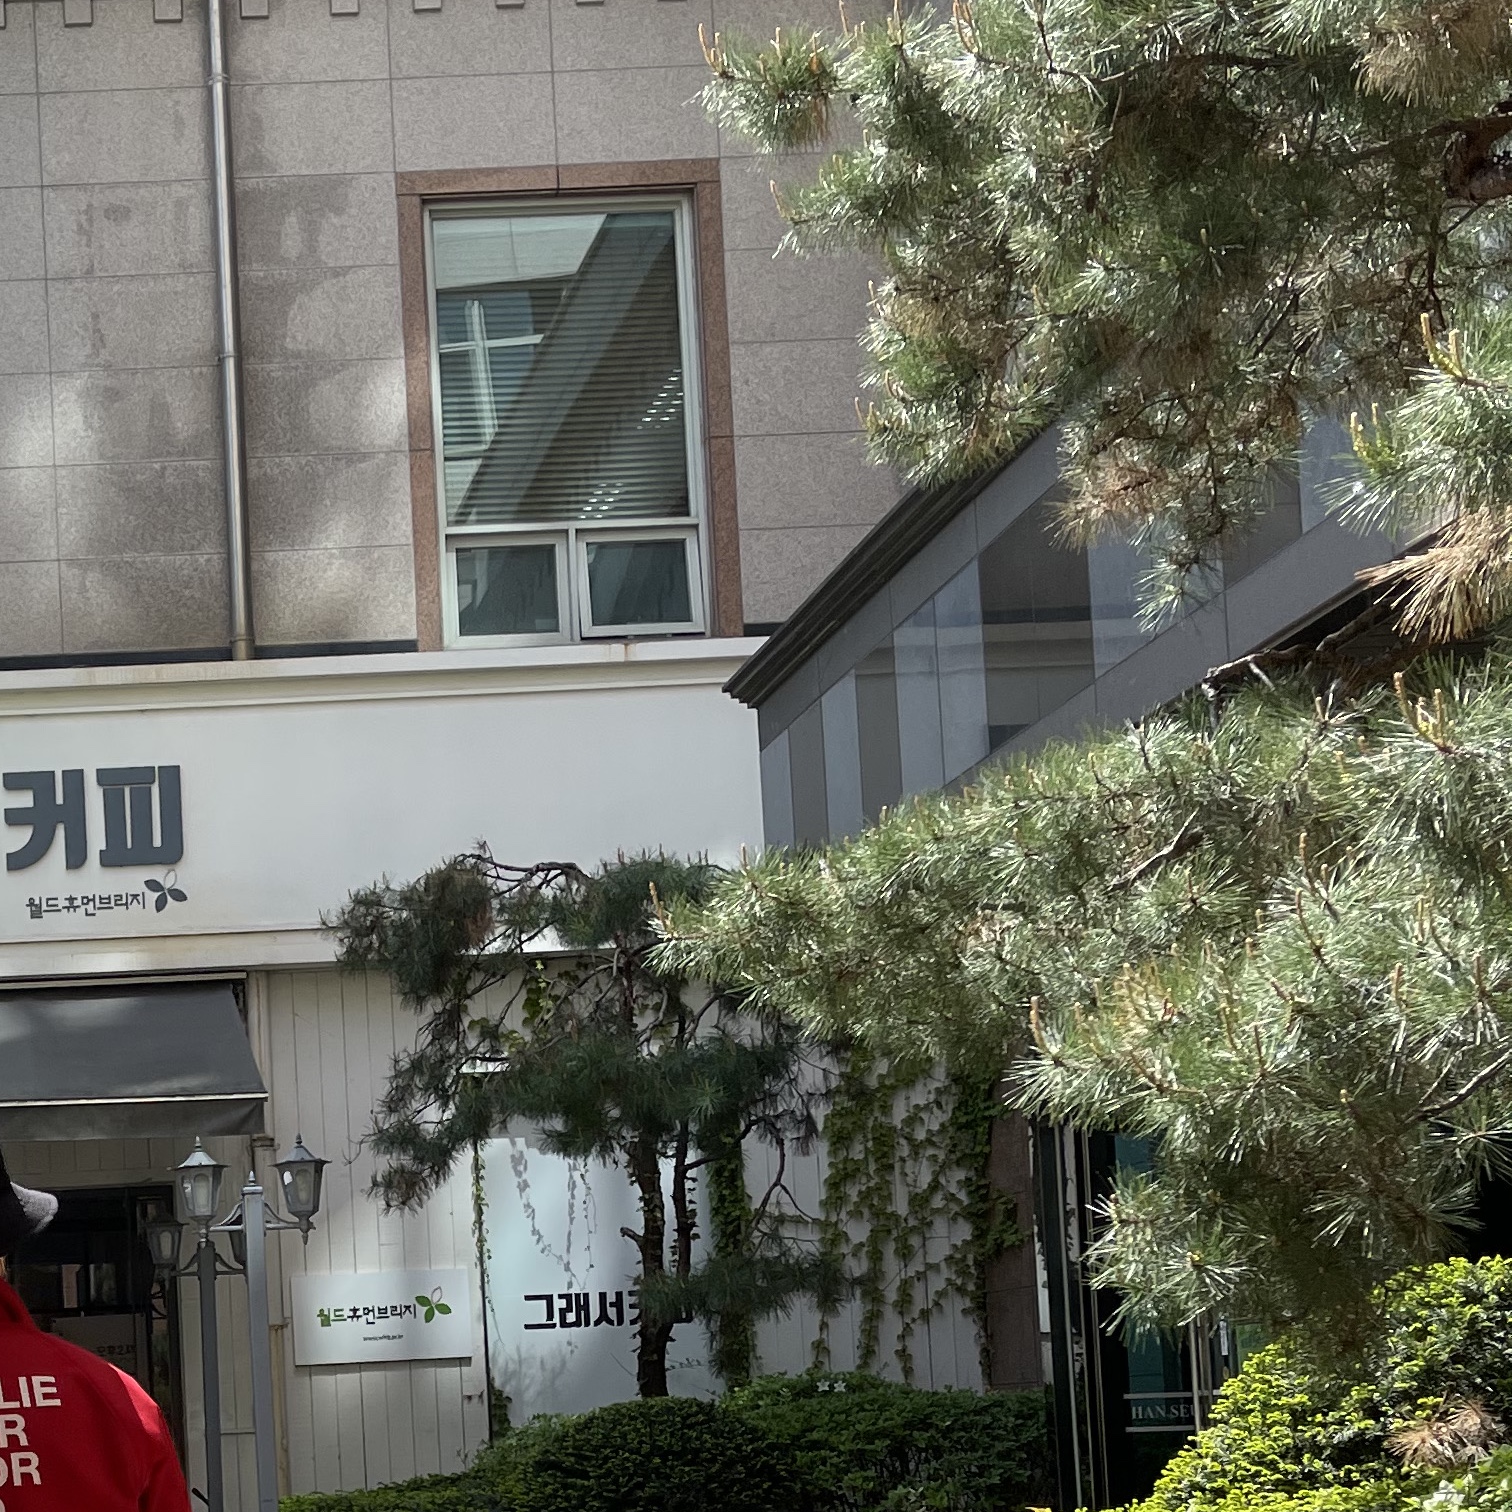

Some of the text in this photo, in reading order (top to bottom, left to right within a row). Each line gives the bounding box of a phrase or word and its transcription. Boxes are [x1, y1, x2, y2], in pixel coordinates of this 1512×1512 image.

[25, 891, 146, 920] 월드휴먼브리지
[316, 1303, 417, 1328] 월드휴먼브리지
[523, 1289, 695, 1331] 그래서
